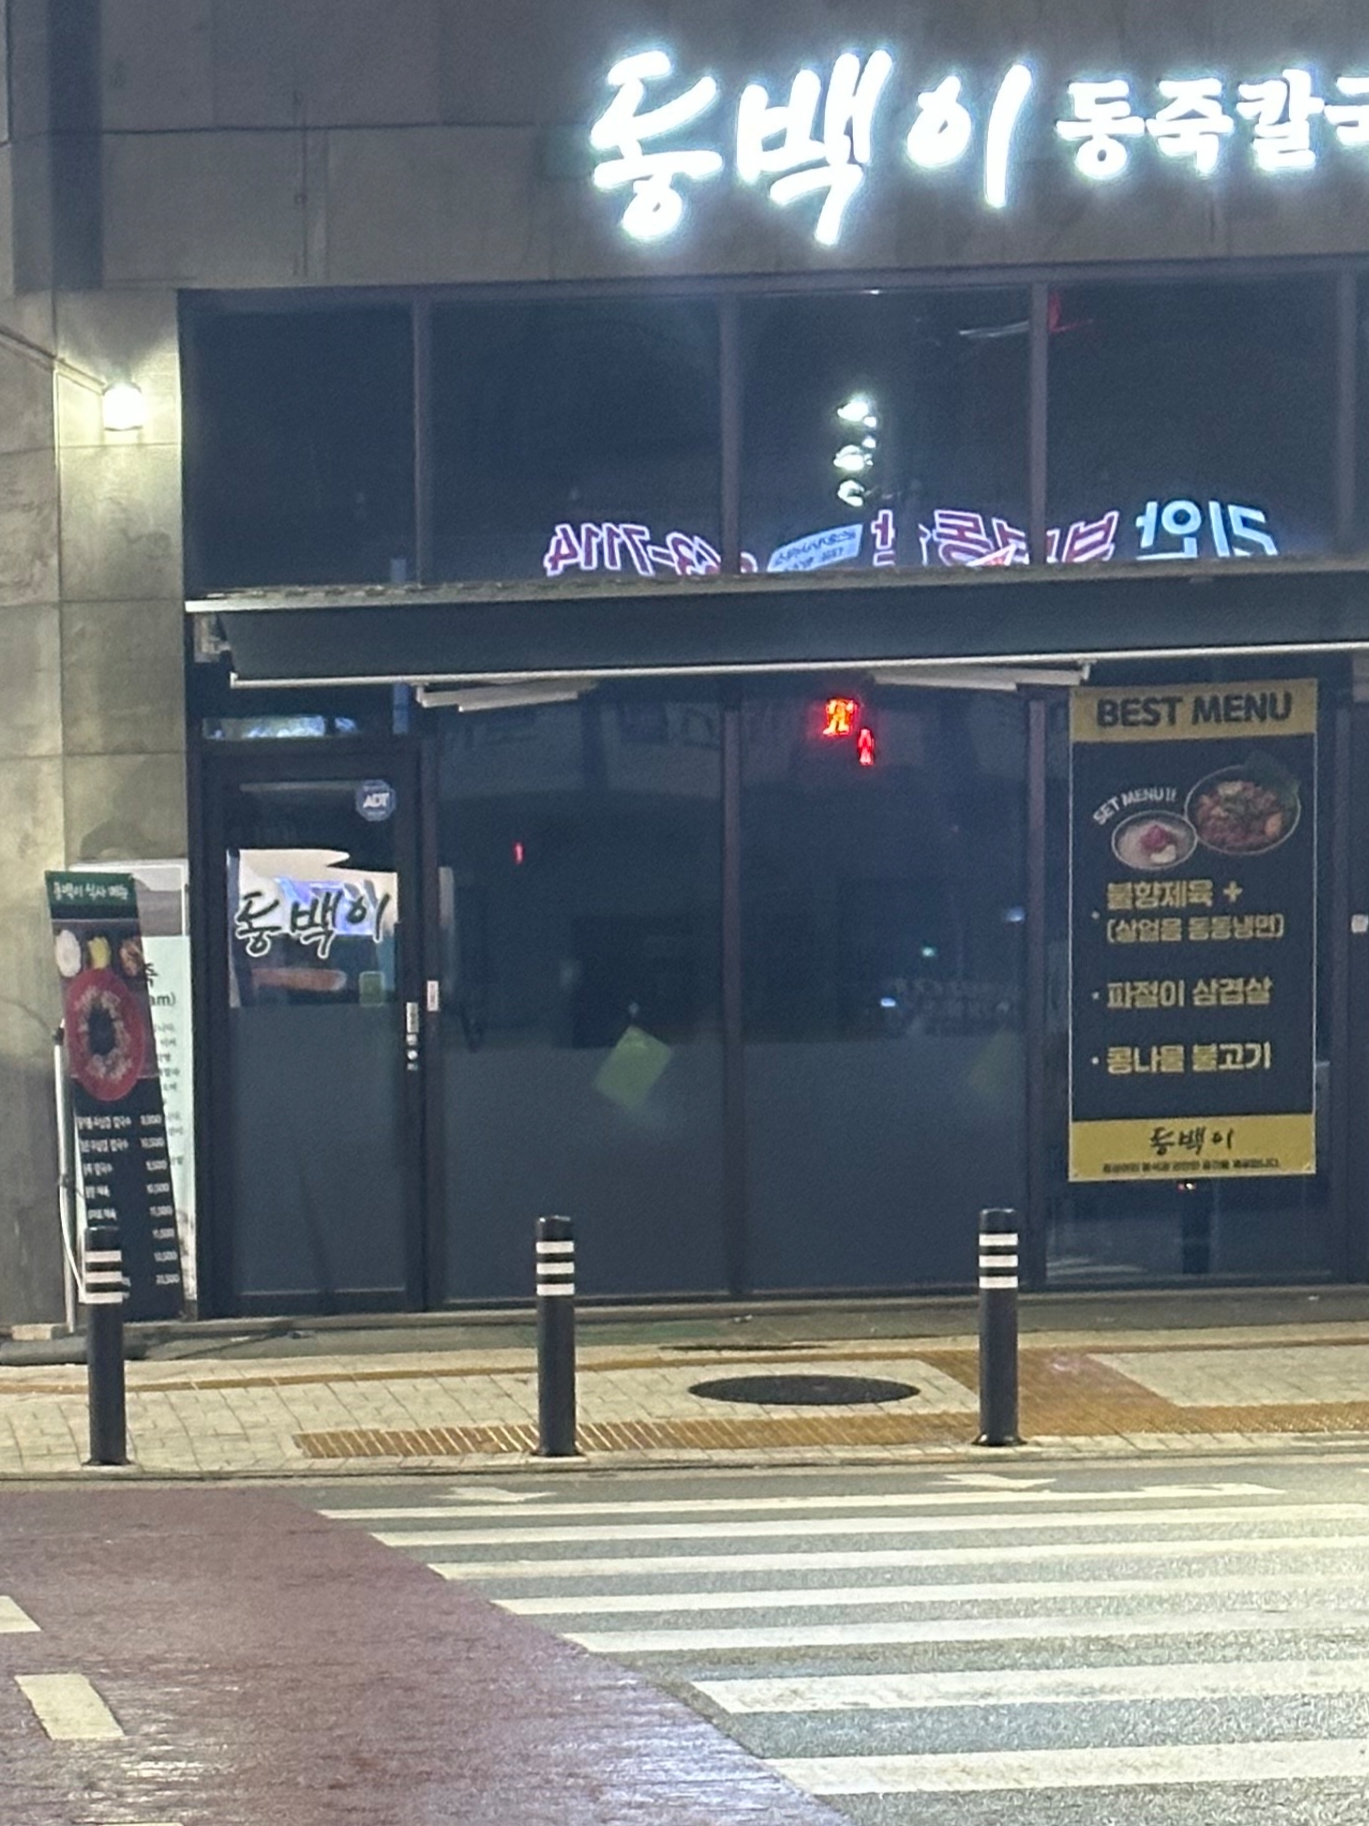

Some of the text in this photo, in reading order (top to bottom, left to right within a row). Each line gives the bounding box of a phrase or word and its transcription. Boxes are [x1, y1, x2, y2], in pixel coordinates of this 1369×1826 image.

[590, 48, 1033, 245] 동백이
[1096, 691, 1293, 729] BEST MENU
[362, 792, 391, 809] ADT
[1091, 796, 1121, 826] SET
[1107, 878, 1214, 910] 불향제육
[234, 889, 391, 960] 동백이
[1192, 975, 1273, 1007] 삼겹살
[1107, 1041, 1272, 1074] 콩나물 불고기
[1149, 1125, 1235, 1156] 동백이
